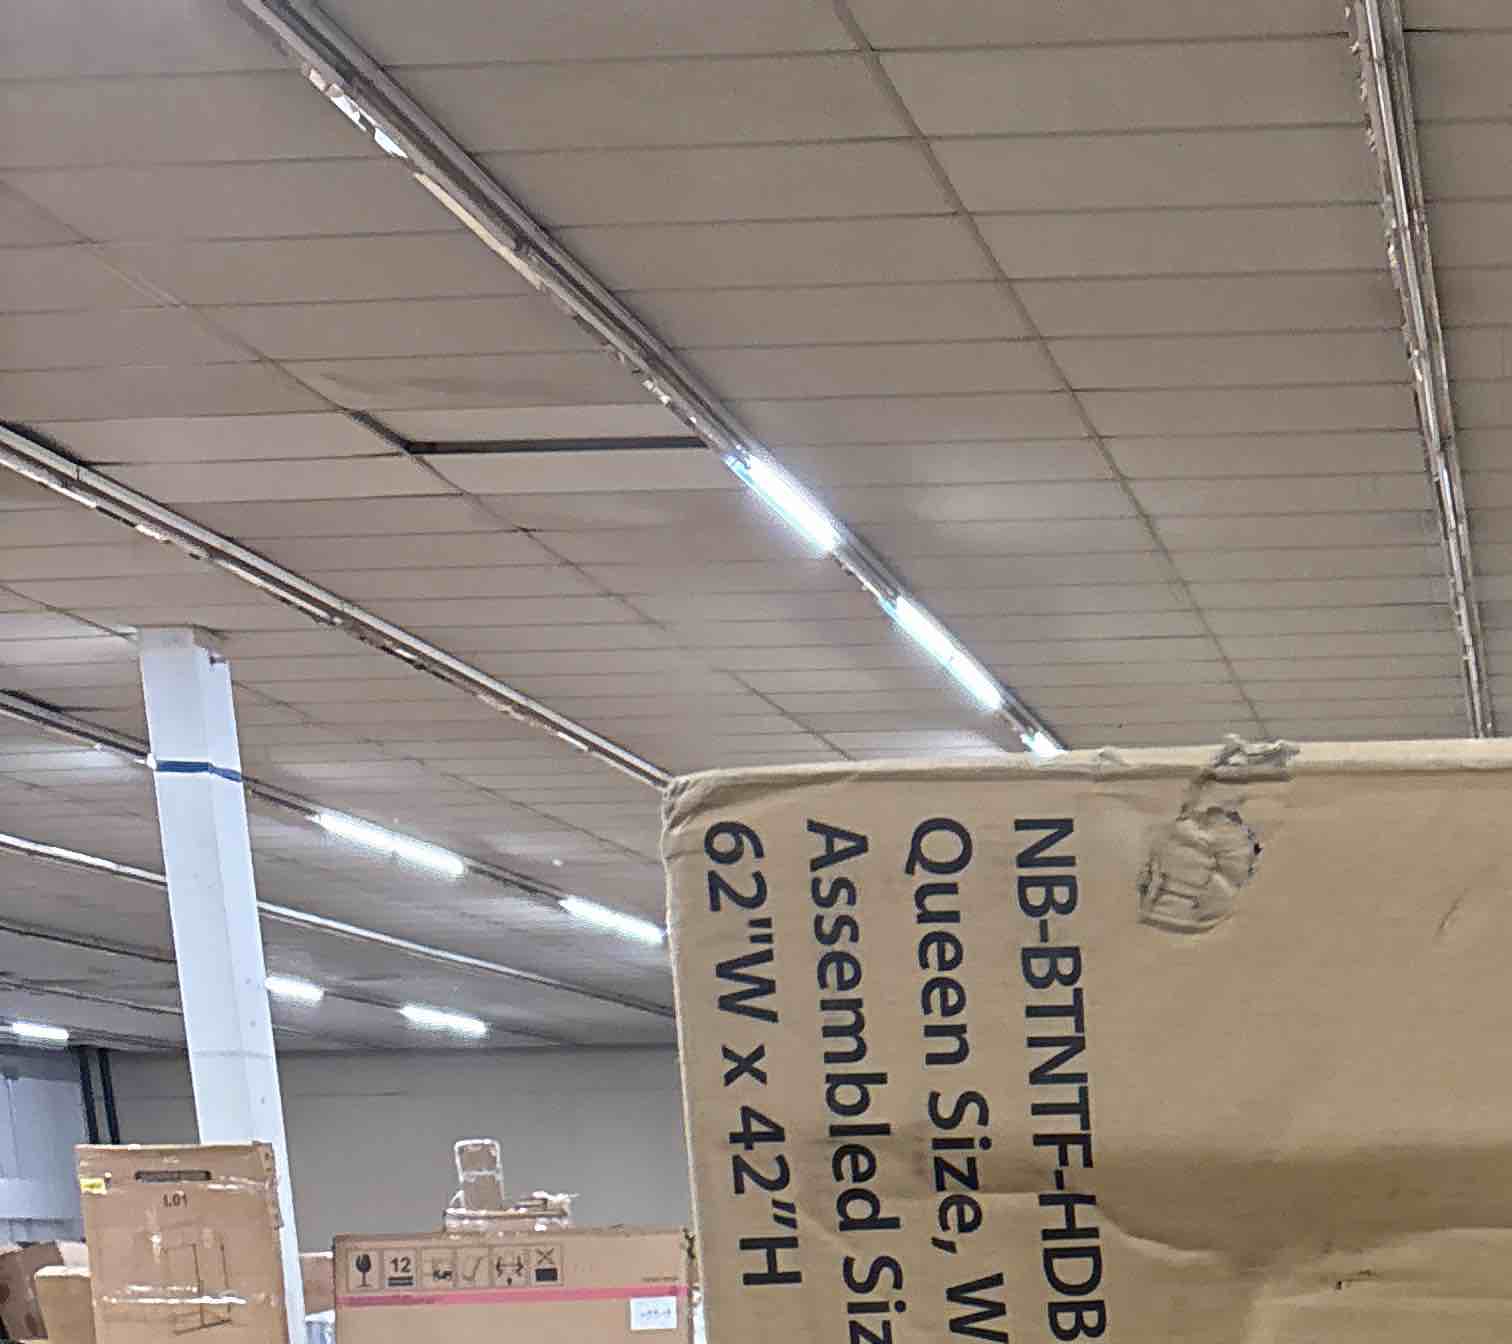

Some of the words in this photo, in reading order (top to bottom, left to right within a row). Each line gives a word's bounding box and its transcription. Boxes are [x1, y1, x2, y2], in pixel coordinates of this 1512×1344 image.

[903, 817, 973, 1066] Queen
[721, 1043, 768, 1087] x
[806, 819, 902, 1233] Assembled
[927, 1090, 993, 1254] Size,
[390, 1257, 411, 1273] 12
